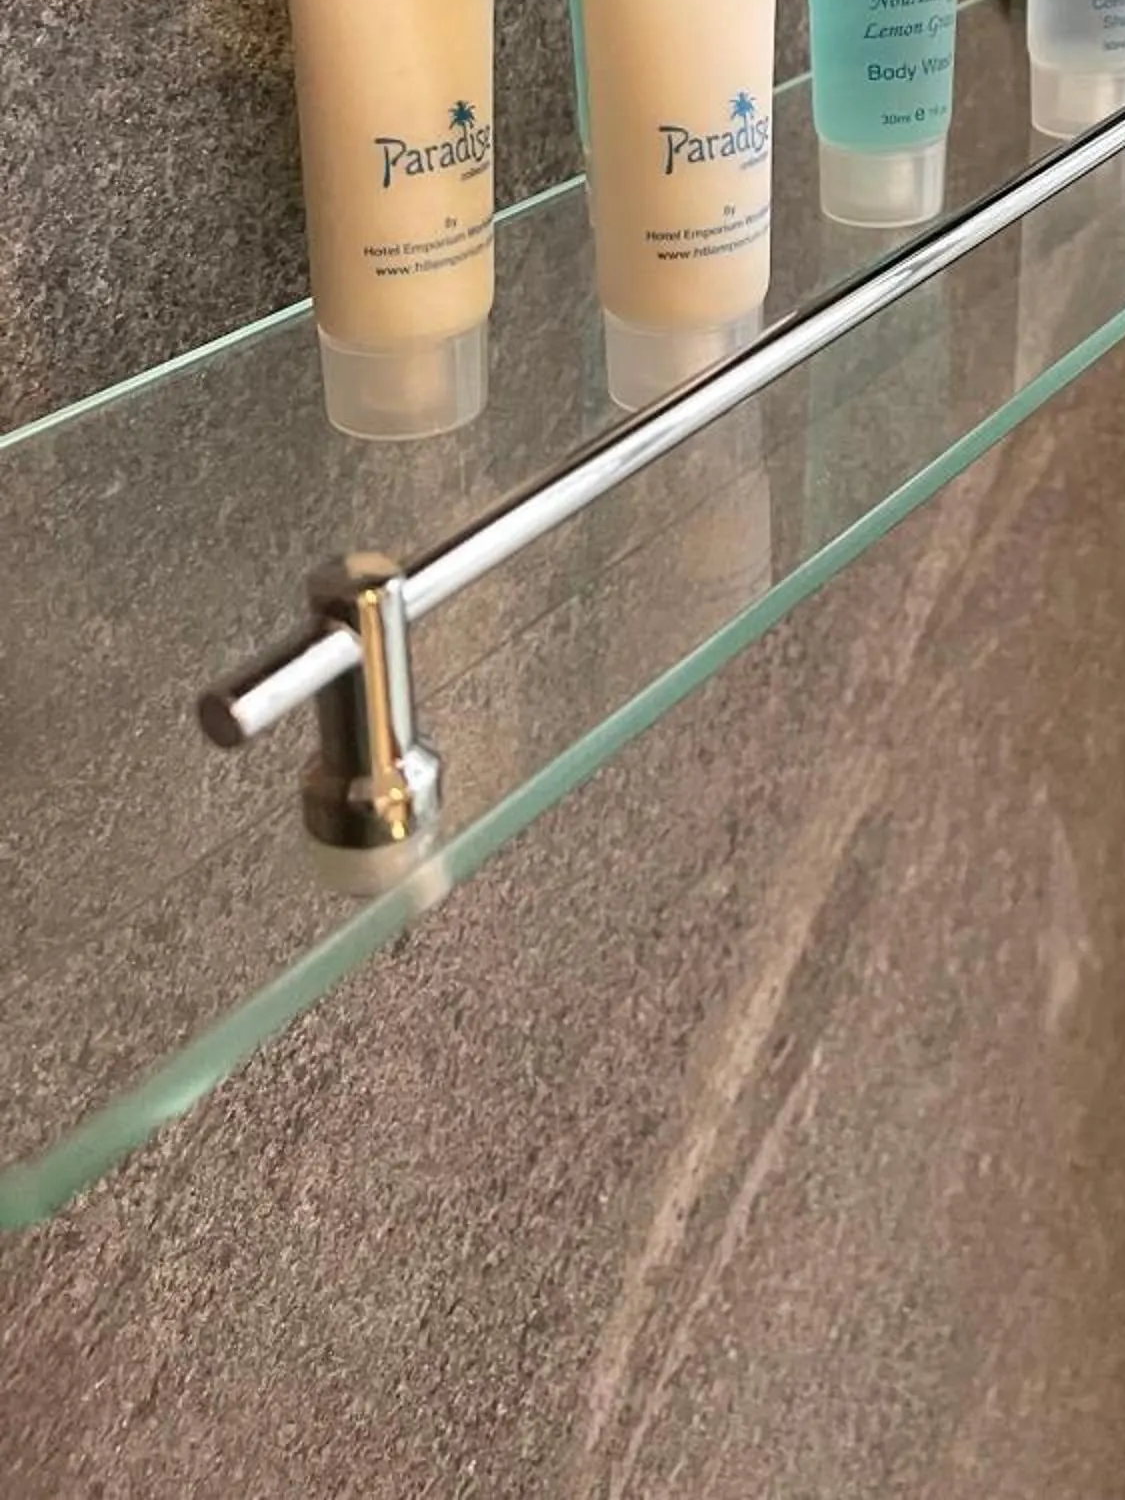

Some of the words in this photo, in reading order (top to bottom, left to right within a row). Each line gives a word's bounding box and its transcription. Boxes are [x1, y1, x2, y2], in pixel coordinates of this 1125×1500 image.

[863, 21, 924, 39] Lemon
[867, 62, 917, 82] Body
[363, 245, 401, 258] Hotel
